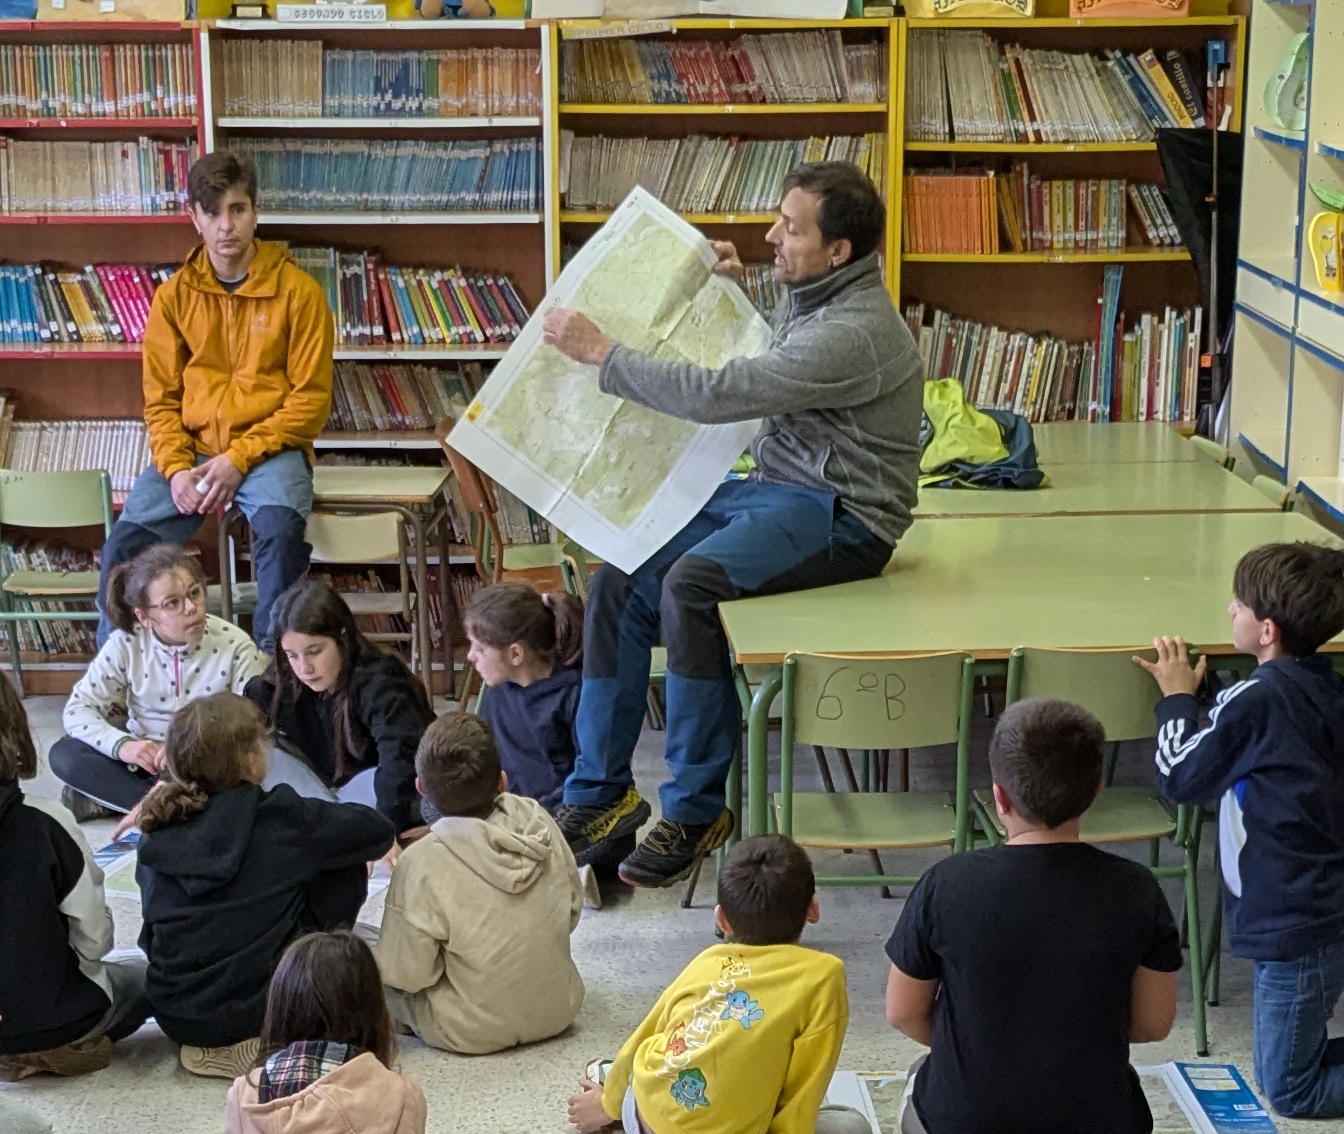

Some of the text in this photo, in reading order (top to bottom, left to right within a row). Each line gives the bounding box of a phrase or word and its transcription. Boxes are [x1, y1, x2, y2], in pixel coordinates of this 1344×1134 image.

[293, 9, 384, 19] SEGUNDO CICLO
[816, 666, 906, 720] 6ºB
